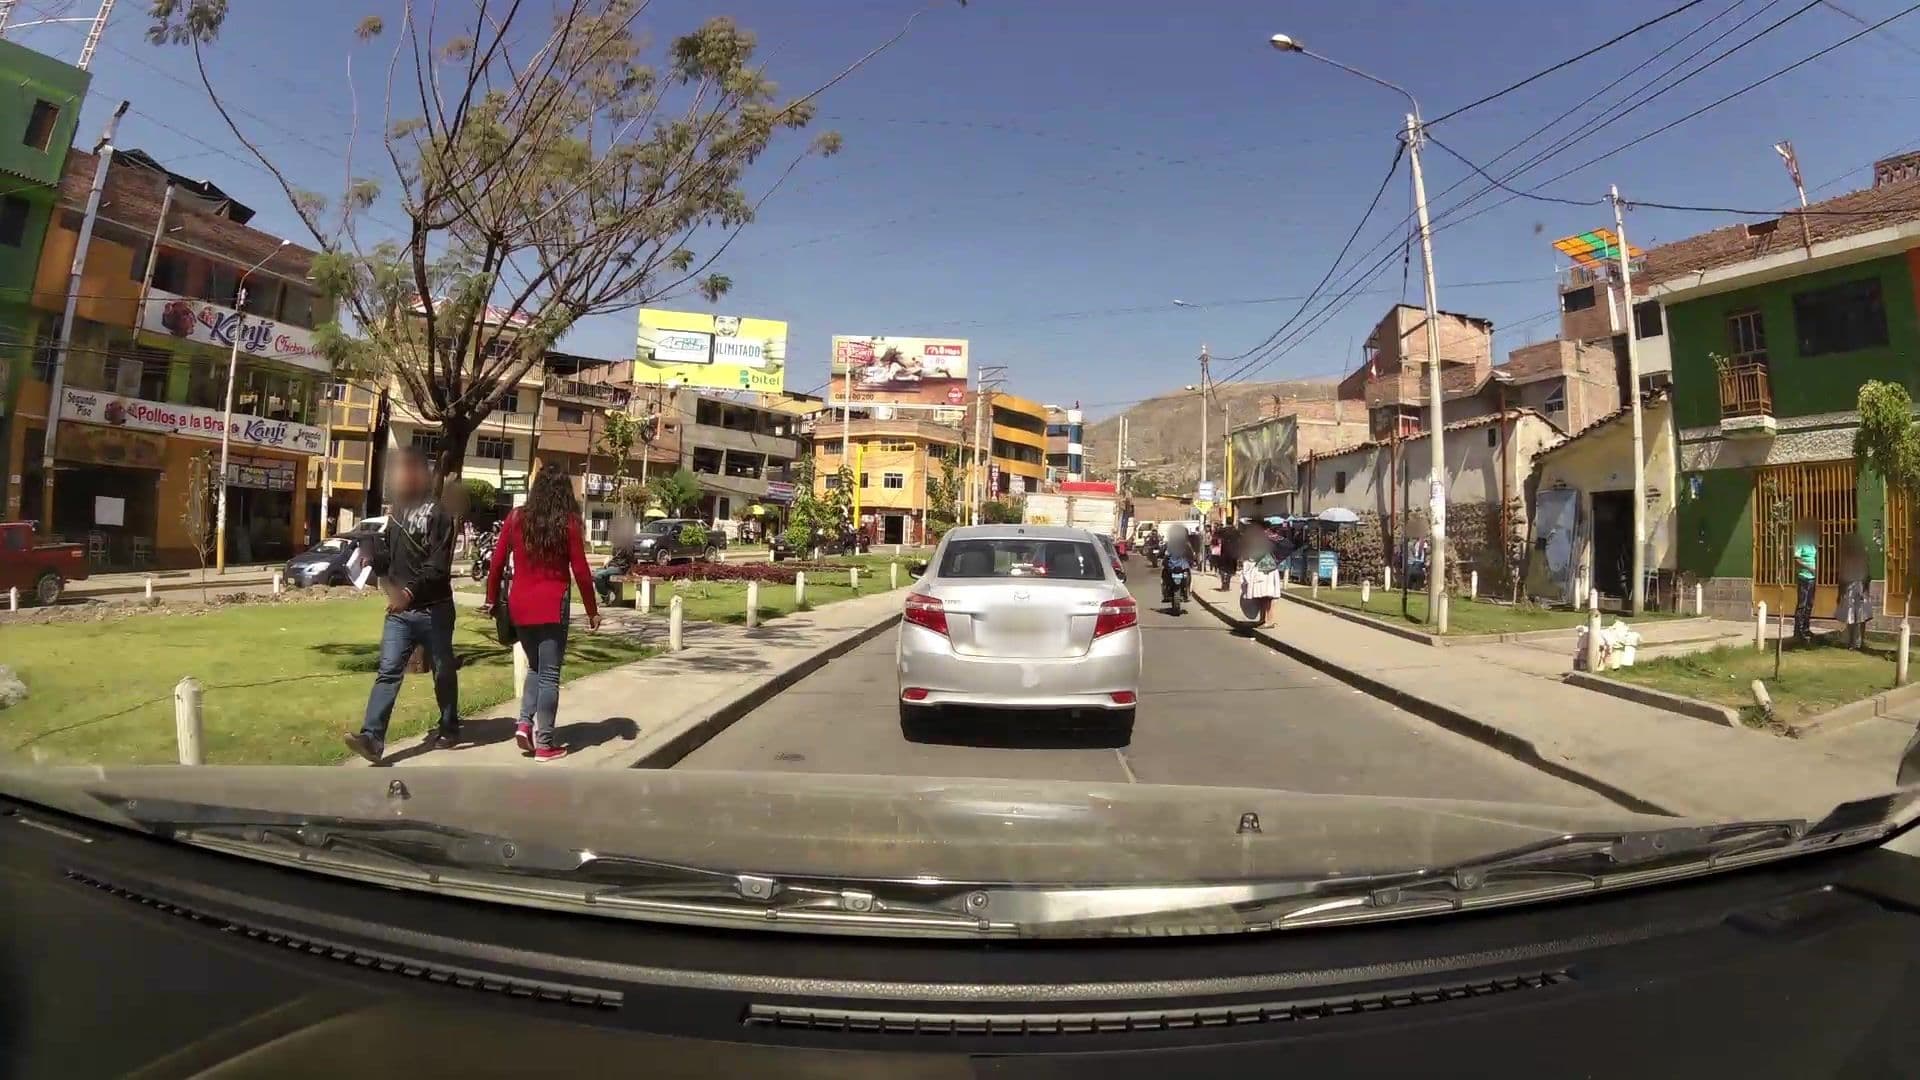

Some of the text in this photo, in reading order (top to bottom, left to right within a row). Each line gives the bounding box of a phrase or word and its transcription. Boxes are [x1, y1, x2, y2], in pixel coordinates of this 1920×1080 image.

[715, 341, 761, 358] ILIMITADO
[751, 374, 780, 386] bitel
[75, 403, 93, 417] Piso
[138, 406, 288, 443] Pollos a la Braa Kanji
